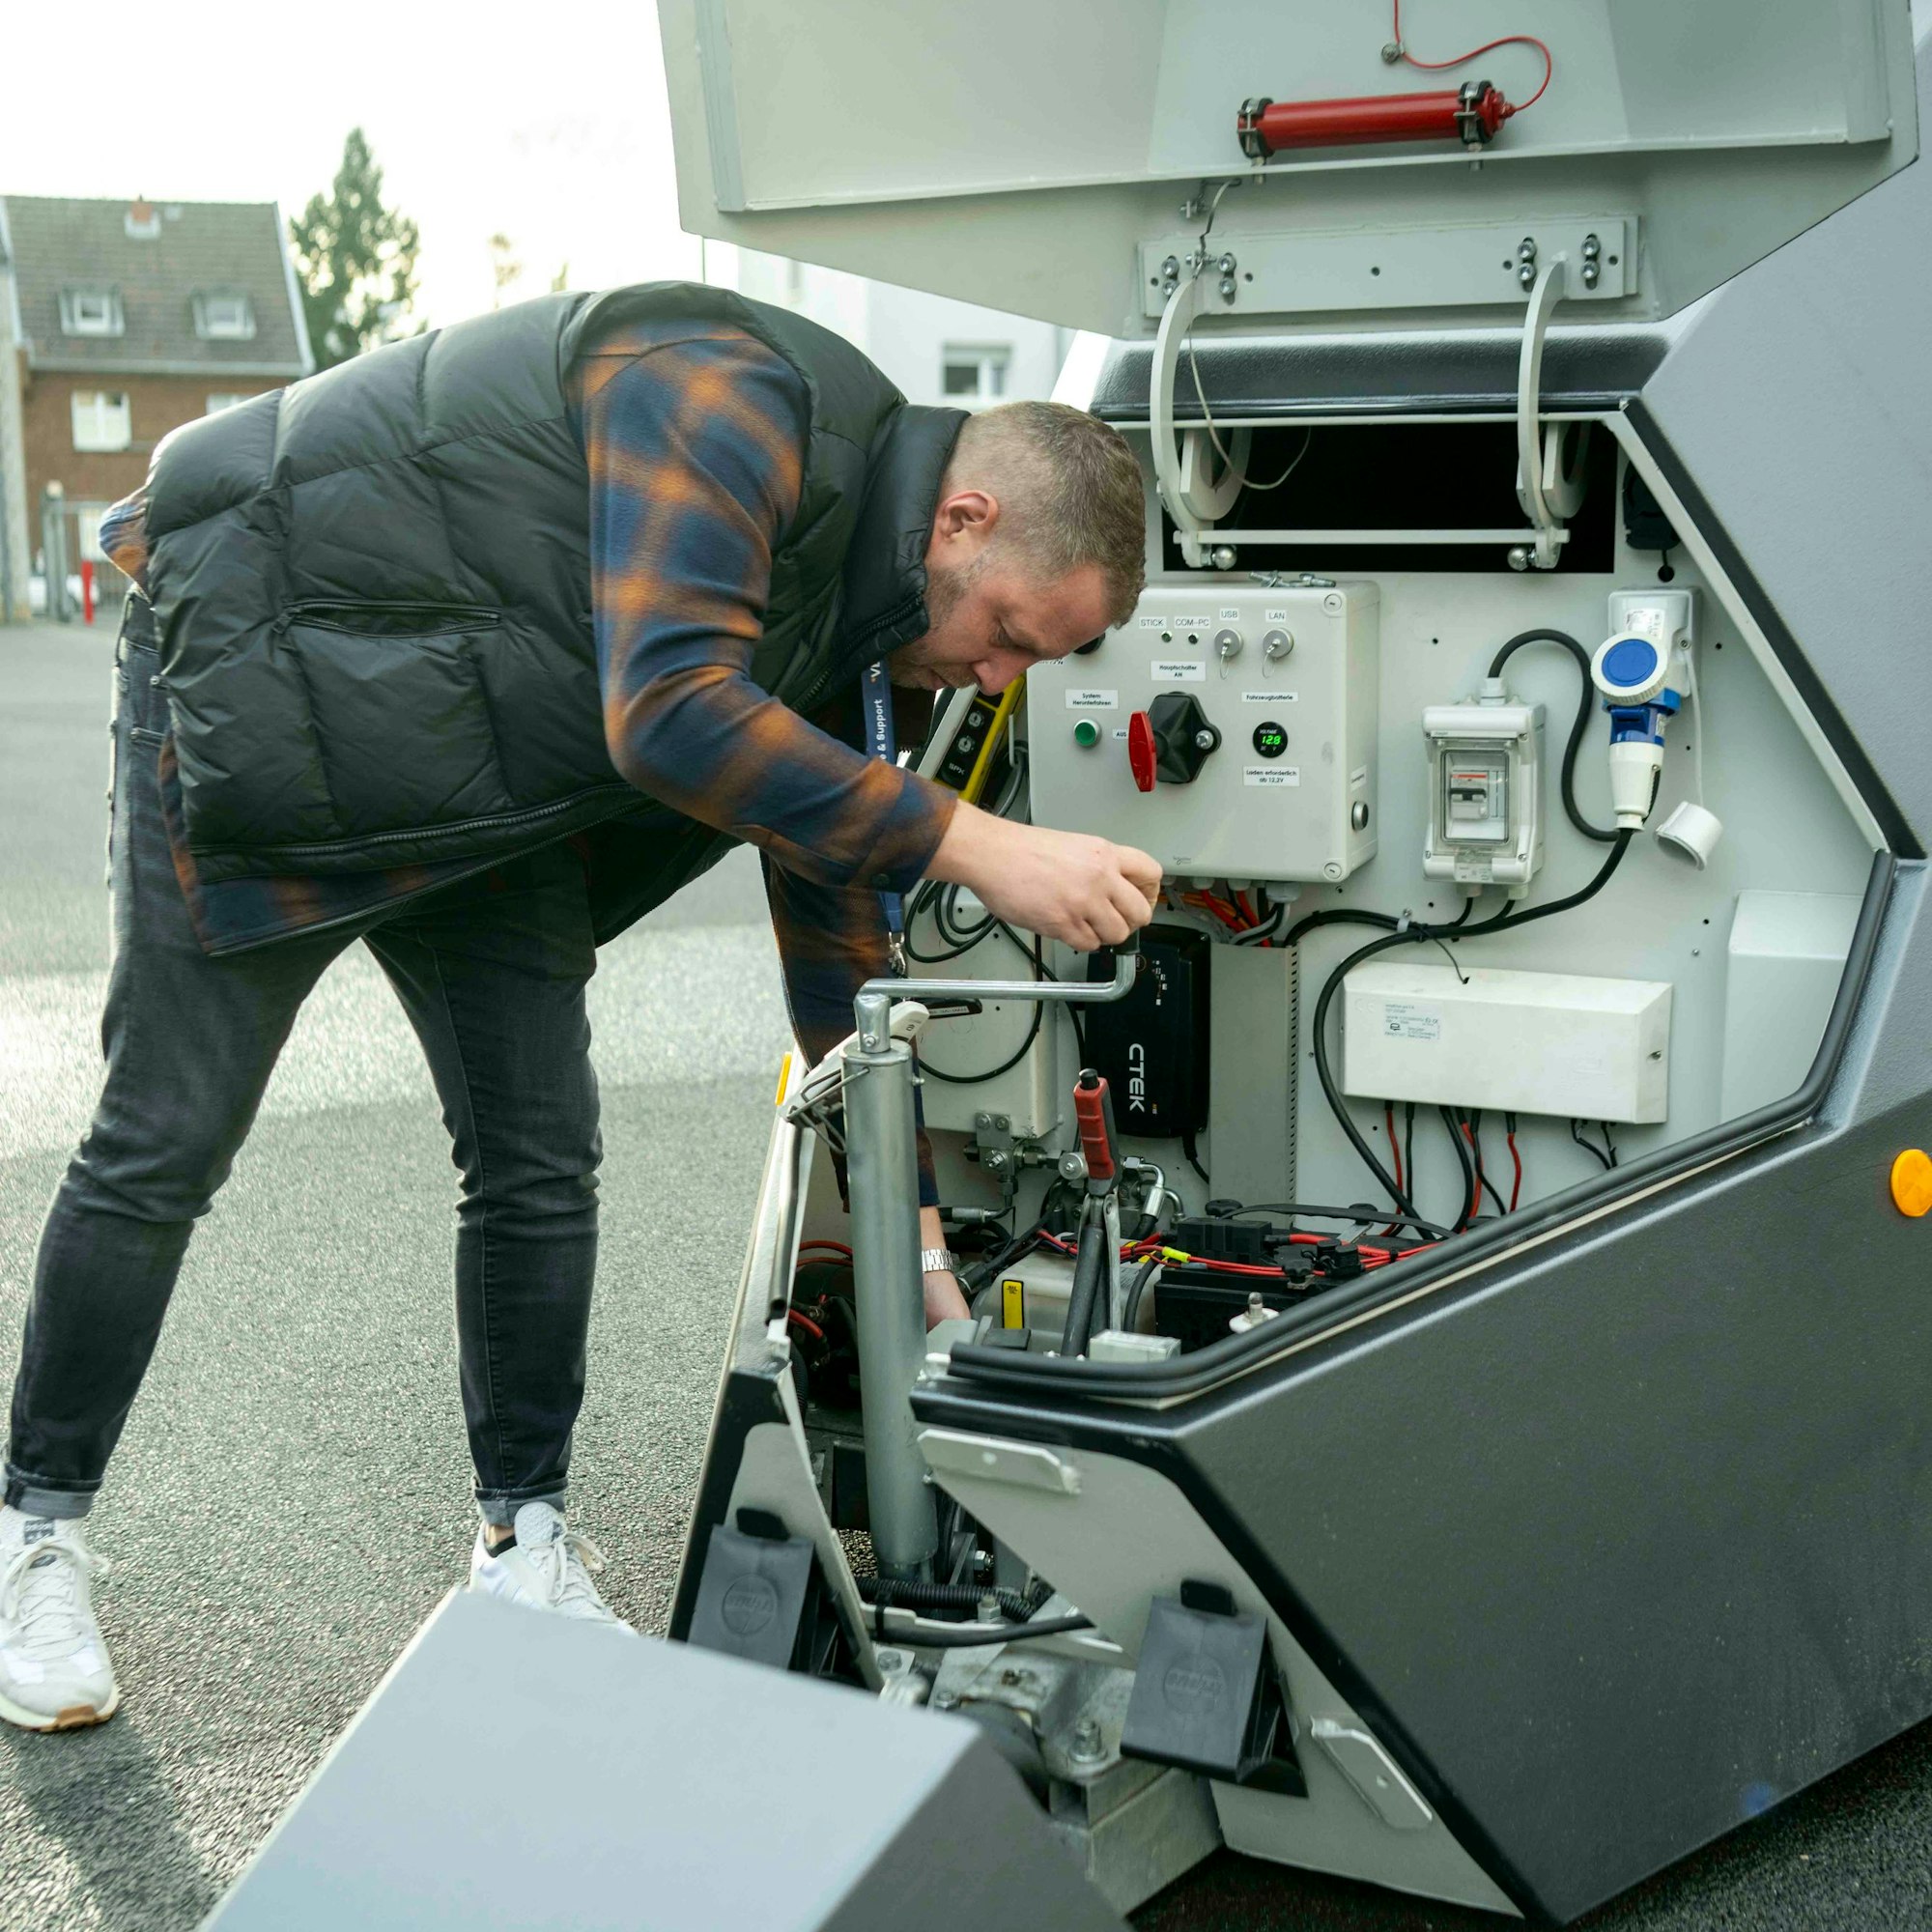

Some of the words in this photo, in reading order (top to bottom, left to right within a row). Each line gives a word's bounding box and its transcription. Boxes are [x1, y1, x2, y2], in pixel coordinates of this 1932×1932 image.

[1220, 610, 1238, 619] USB
[1268, 611, 1285, 620] LAN
[1175, 618, 1209, 627] COM-PC
[873, 698, 887, 741] Support
[877, 743, 887, 752] &
[1128, 1042, 1145, 1113] CTEK
